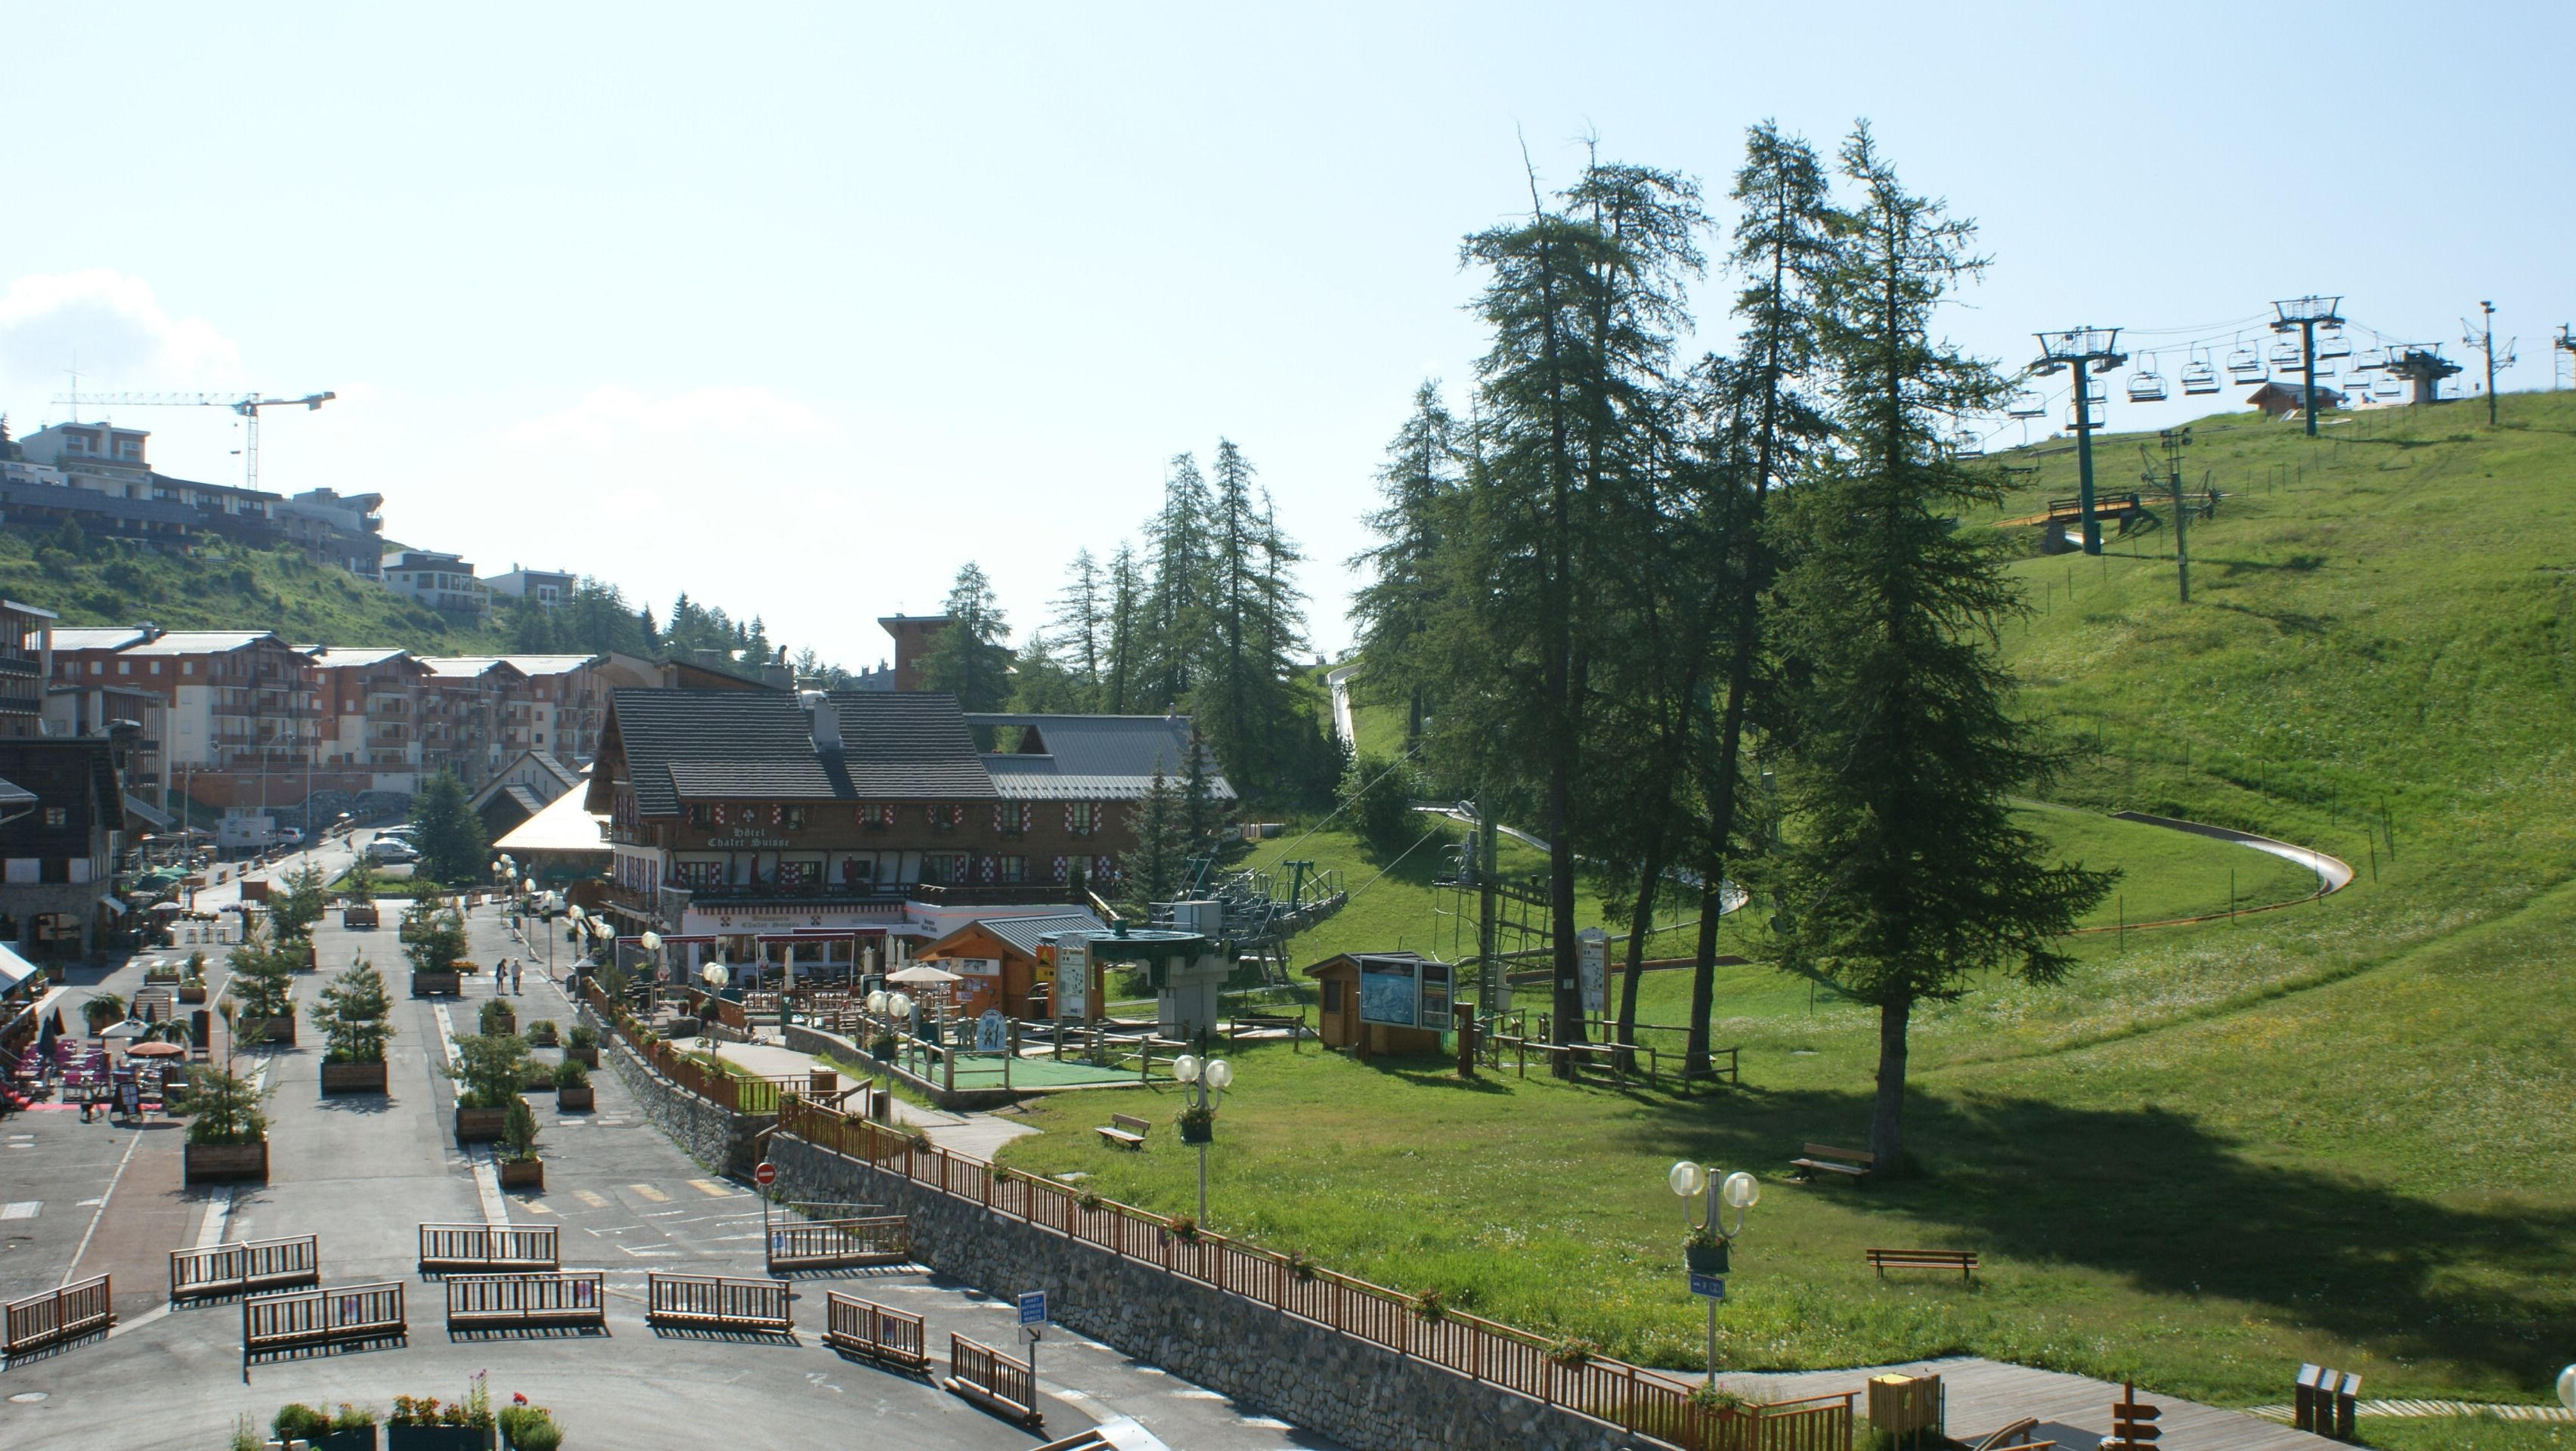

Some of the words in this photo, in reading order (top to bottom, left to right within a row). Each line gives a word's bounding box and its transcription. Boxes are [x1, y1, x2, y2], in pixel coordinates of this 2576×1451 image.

[733, 828, 765, 837] Hôtel
[707, 837, 744, 846] Chalet
[751, 837, 790, 846] Suisse
